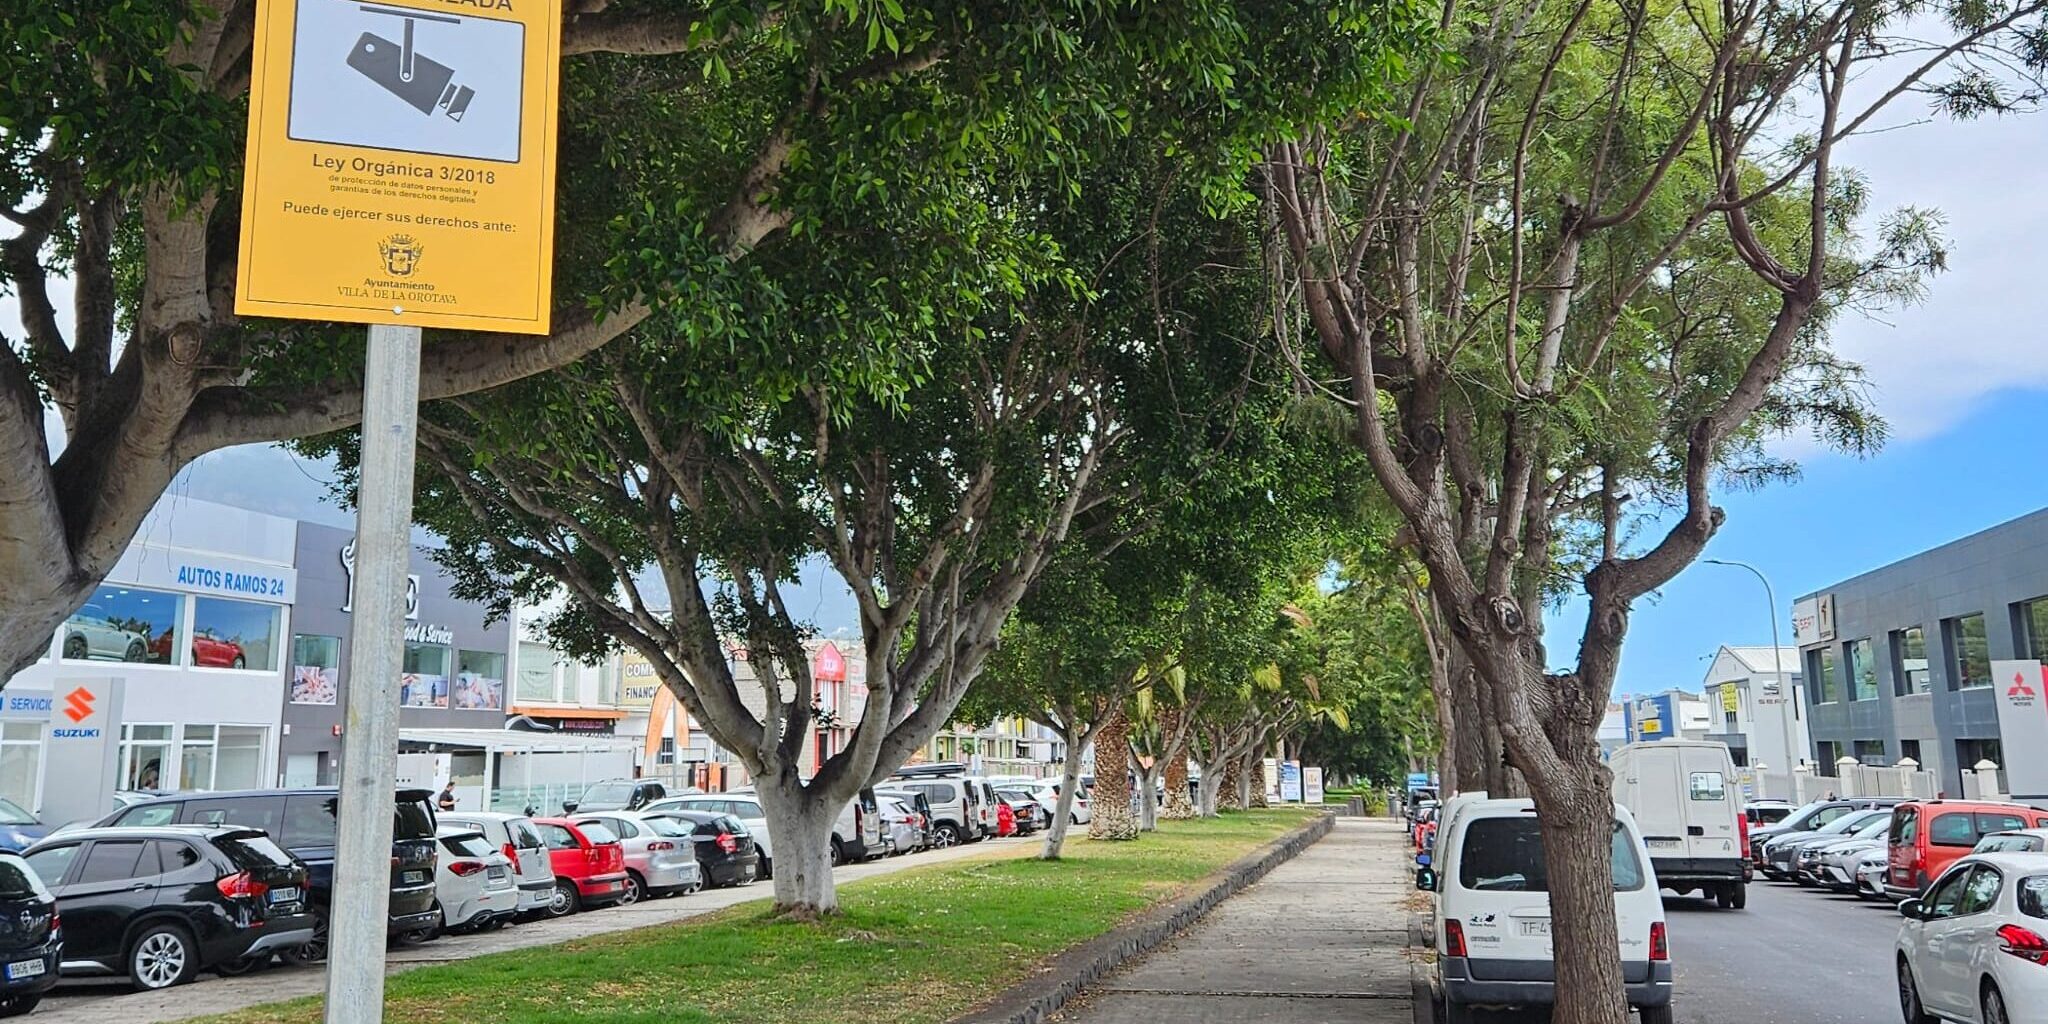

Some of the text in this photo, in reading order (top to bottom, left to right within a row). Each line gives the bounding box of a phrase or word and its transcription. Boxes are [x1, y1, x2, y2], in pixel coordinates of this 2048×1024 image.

[312, 153, 495, 185] Ley Orgánica 3/2018
[384, 189, 397, 197] los
[399, 191, 437, 200] derechos
[389, 180, 399, 188] de
[401, 182, 424, 190] datos
[426, 185, 471, 195] personales
[283, 201, 517, 233] Puede ejercer sus derechos ante:
[364, 278, 435, 291] Ayuntamiento
[337, 286, 458, 304] VILLA DE LA OROTAVA
[178, 565, 284, 596] AUTOS RAMOS 24
[404, 622, 420, 642] ood
[53, 729, 100, 738] SUZUKI
[1521, 921, 1551, 934] TF-4
